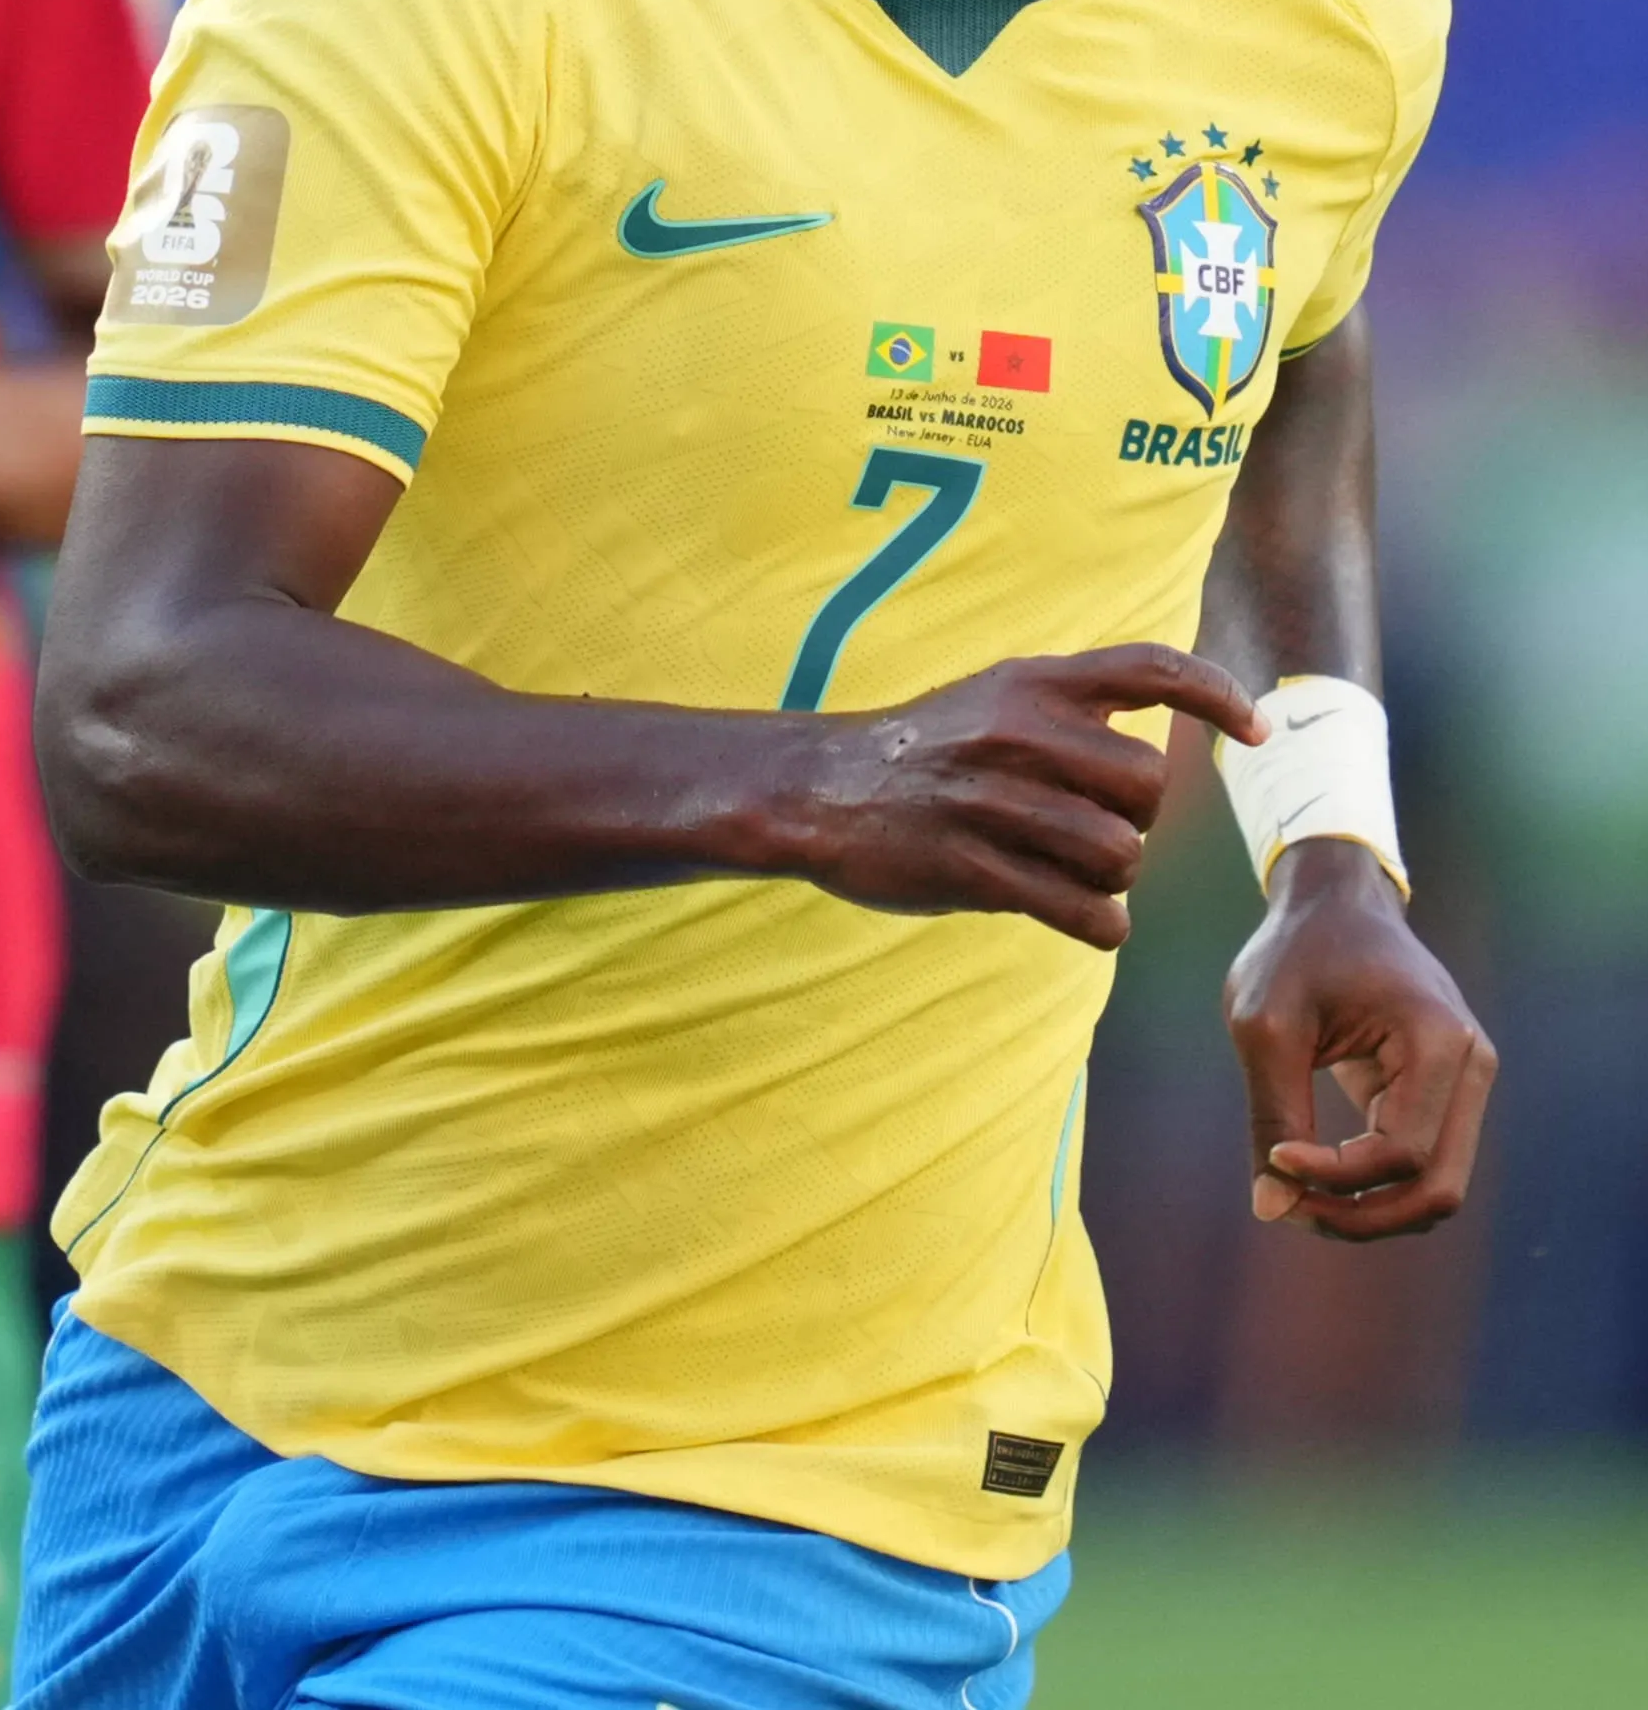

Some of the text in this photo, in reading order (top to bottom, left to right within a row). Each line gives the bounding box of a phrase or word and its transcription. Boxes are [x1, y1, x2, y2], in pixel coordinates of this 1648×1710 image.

[161, 234, 196, 251] FIFA
[136, 269, 215, 285] WORLD CUP
[1197, 263, 1245, 296] CBF
[130, 285, 211, 310] 2026
[949, 350, 965, 363] vs
[890, 388, 1013, 411] 13 de Junho de 2026
[867, 404, 1025, 435] BRASIL vs MARROCOS
[886, 424, 916, 439] New
[918, 428, 955, 446] Jersey
[966, 433, 992, 449] EUA
[1118, 418, 1244, 468] BRASIL
[777, 445, 988, 713] 7
